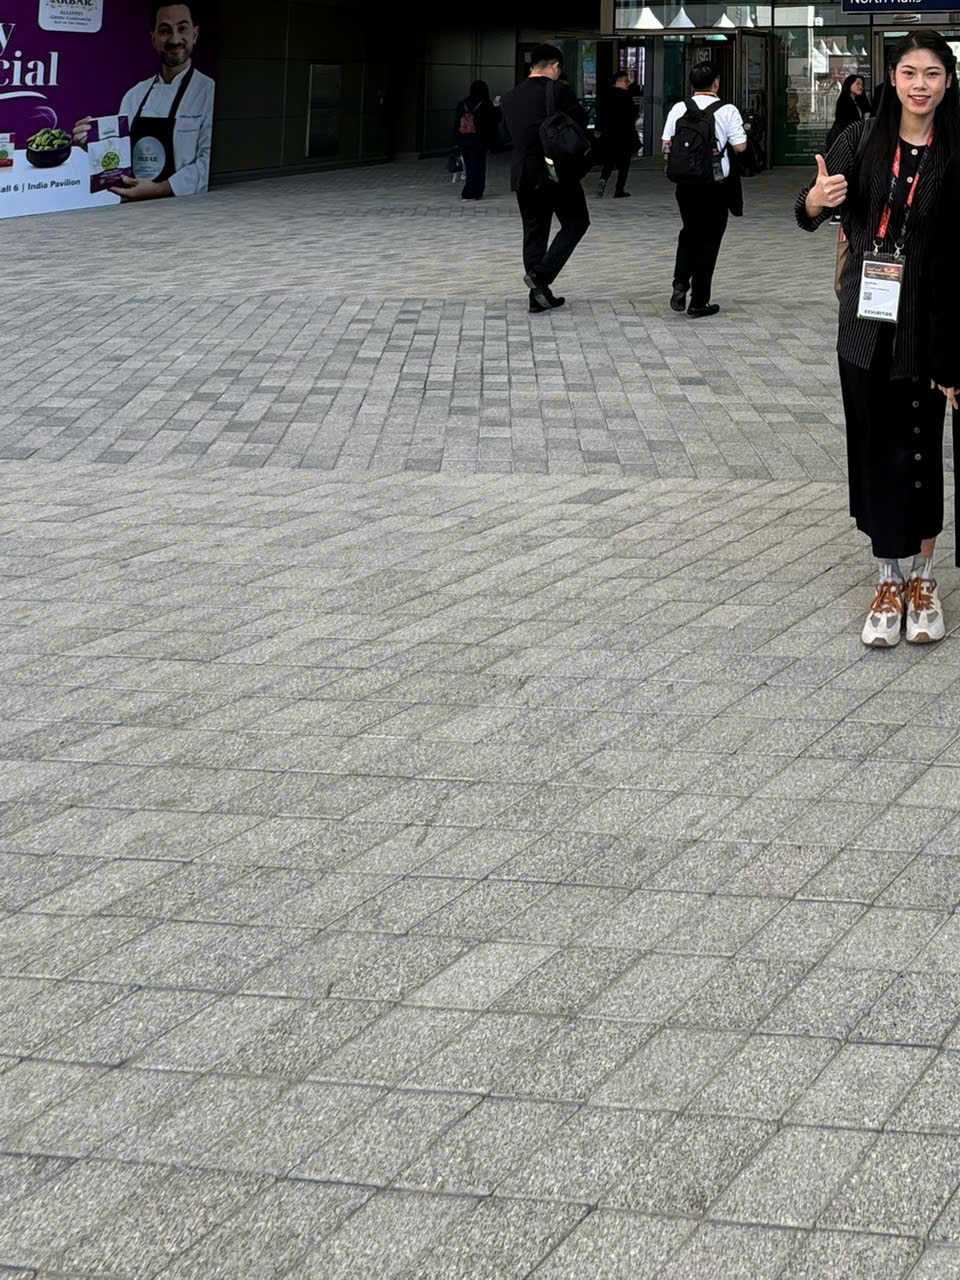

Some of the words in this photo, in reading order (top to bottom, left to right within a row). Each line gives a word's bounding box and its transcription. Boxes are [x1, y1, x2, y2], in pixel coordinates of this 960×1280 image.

[0, 185, 11, 193] all
[13, 184, 19, 192] 6
[28, 181, 48, 190] India
[50, 179, 80, 188] Pavilion
